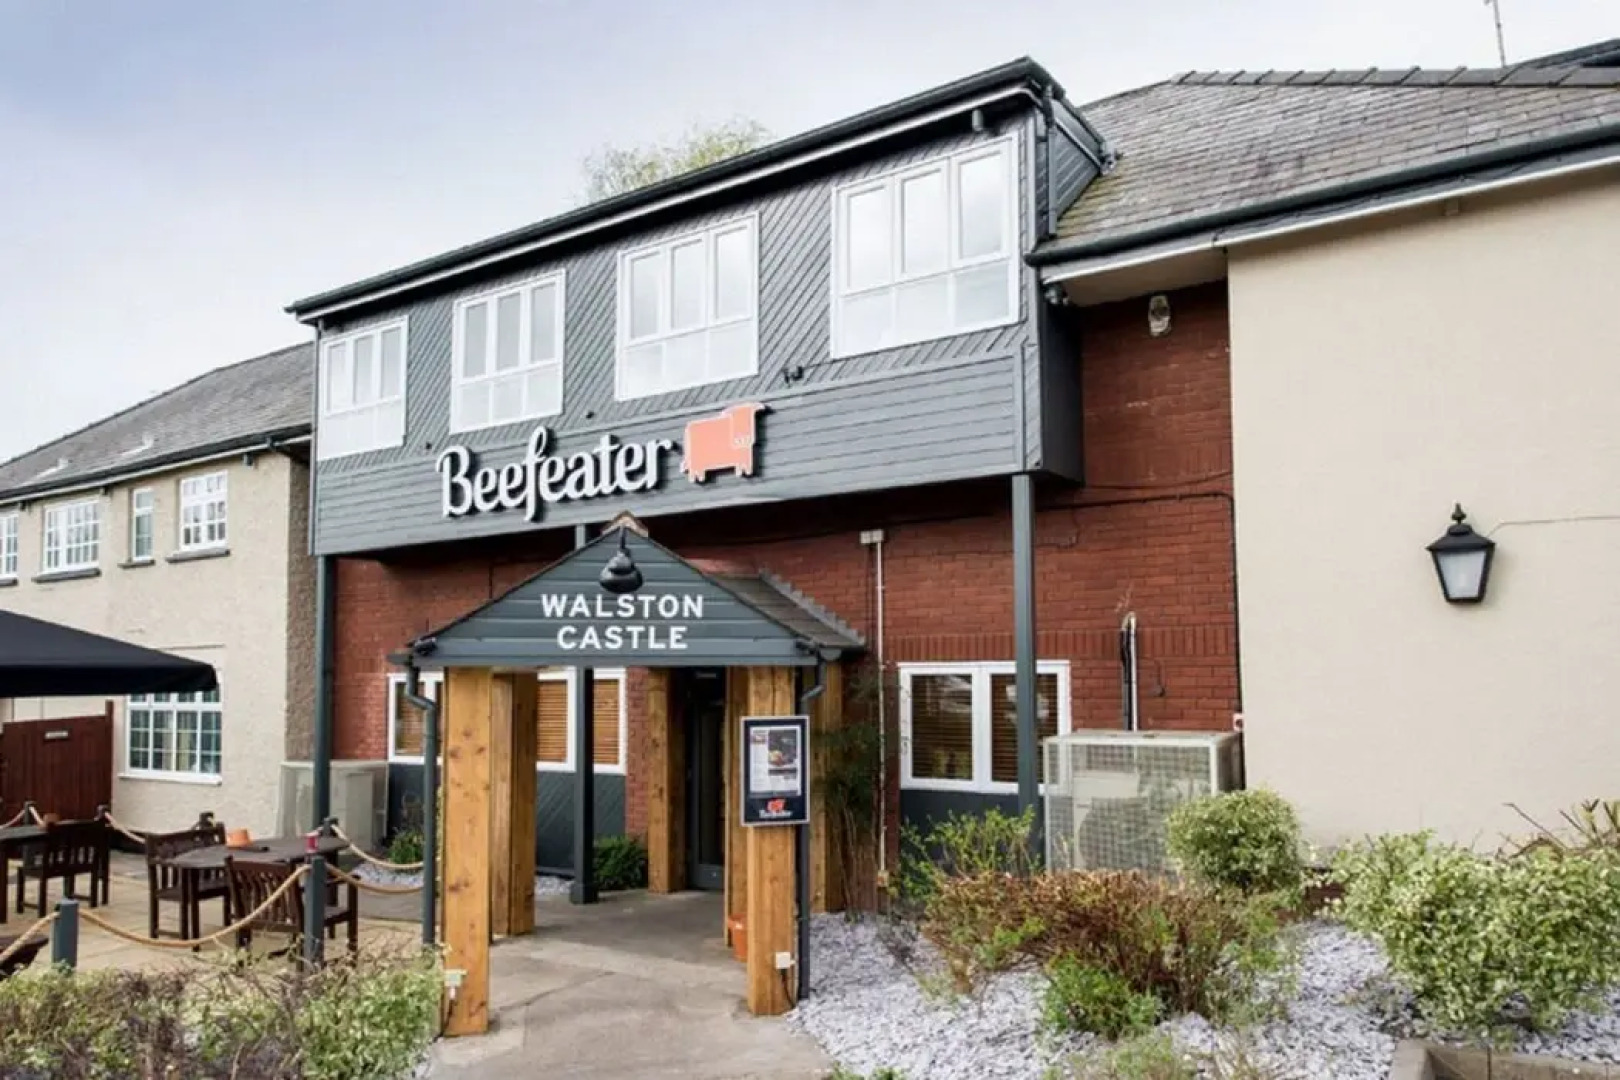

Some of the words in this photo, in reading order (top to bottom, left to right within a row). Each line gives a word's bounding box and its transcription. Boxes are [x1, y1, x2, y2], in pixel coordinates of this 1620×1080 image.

[436, 426, 672, 521] Beefeater
[541, 593, 704, 618] WALSTON
[556, 625, 688, 649] CASTLE
